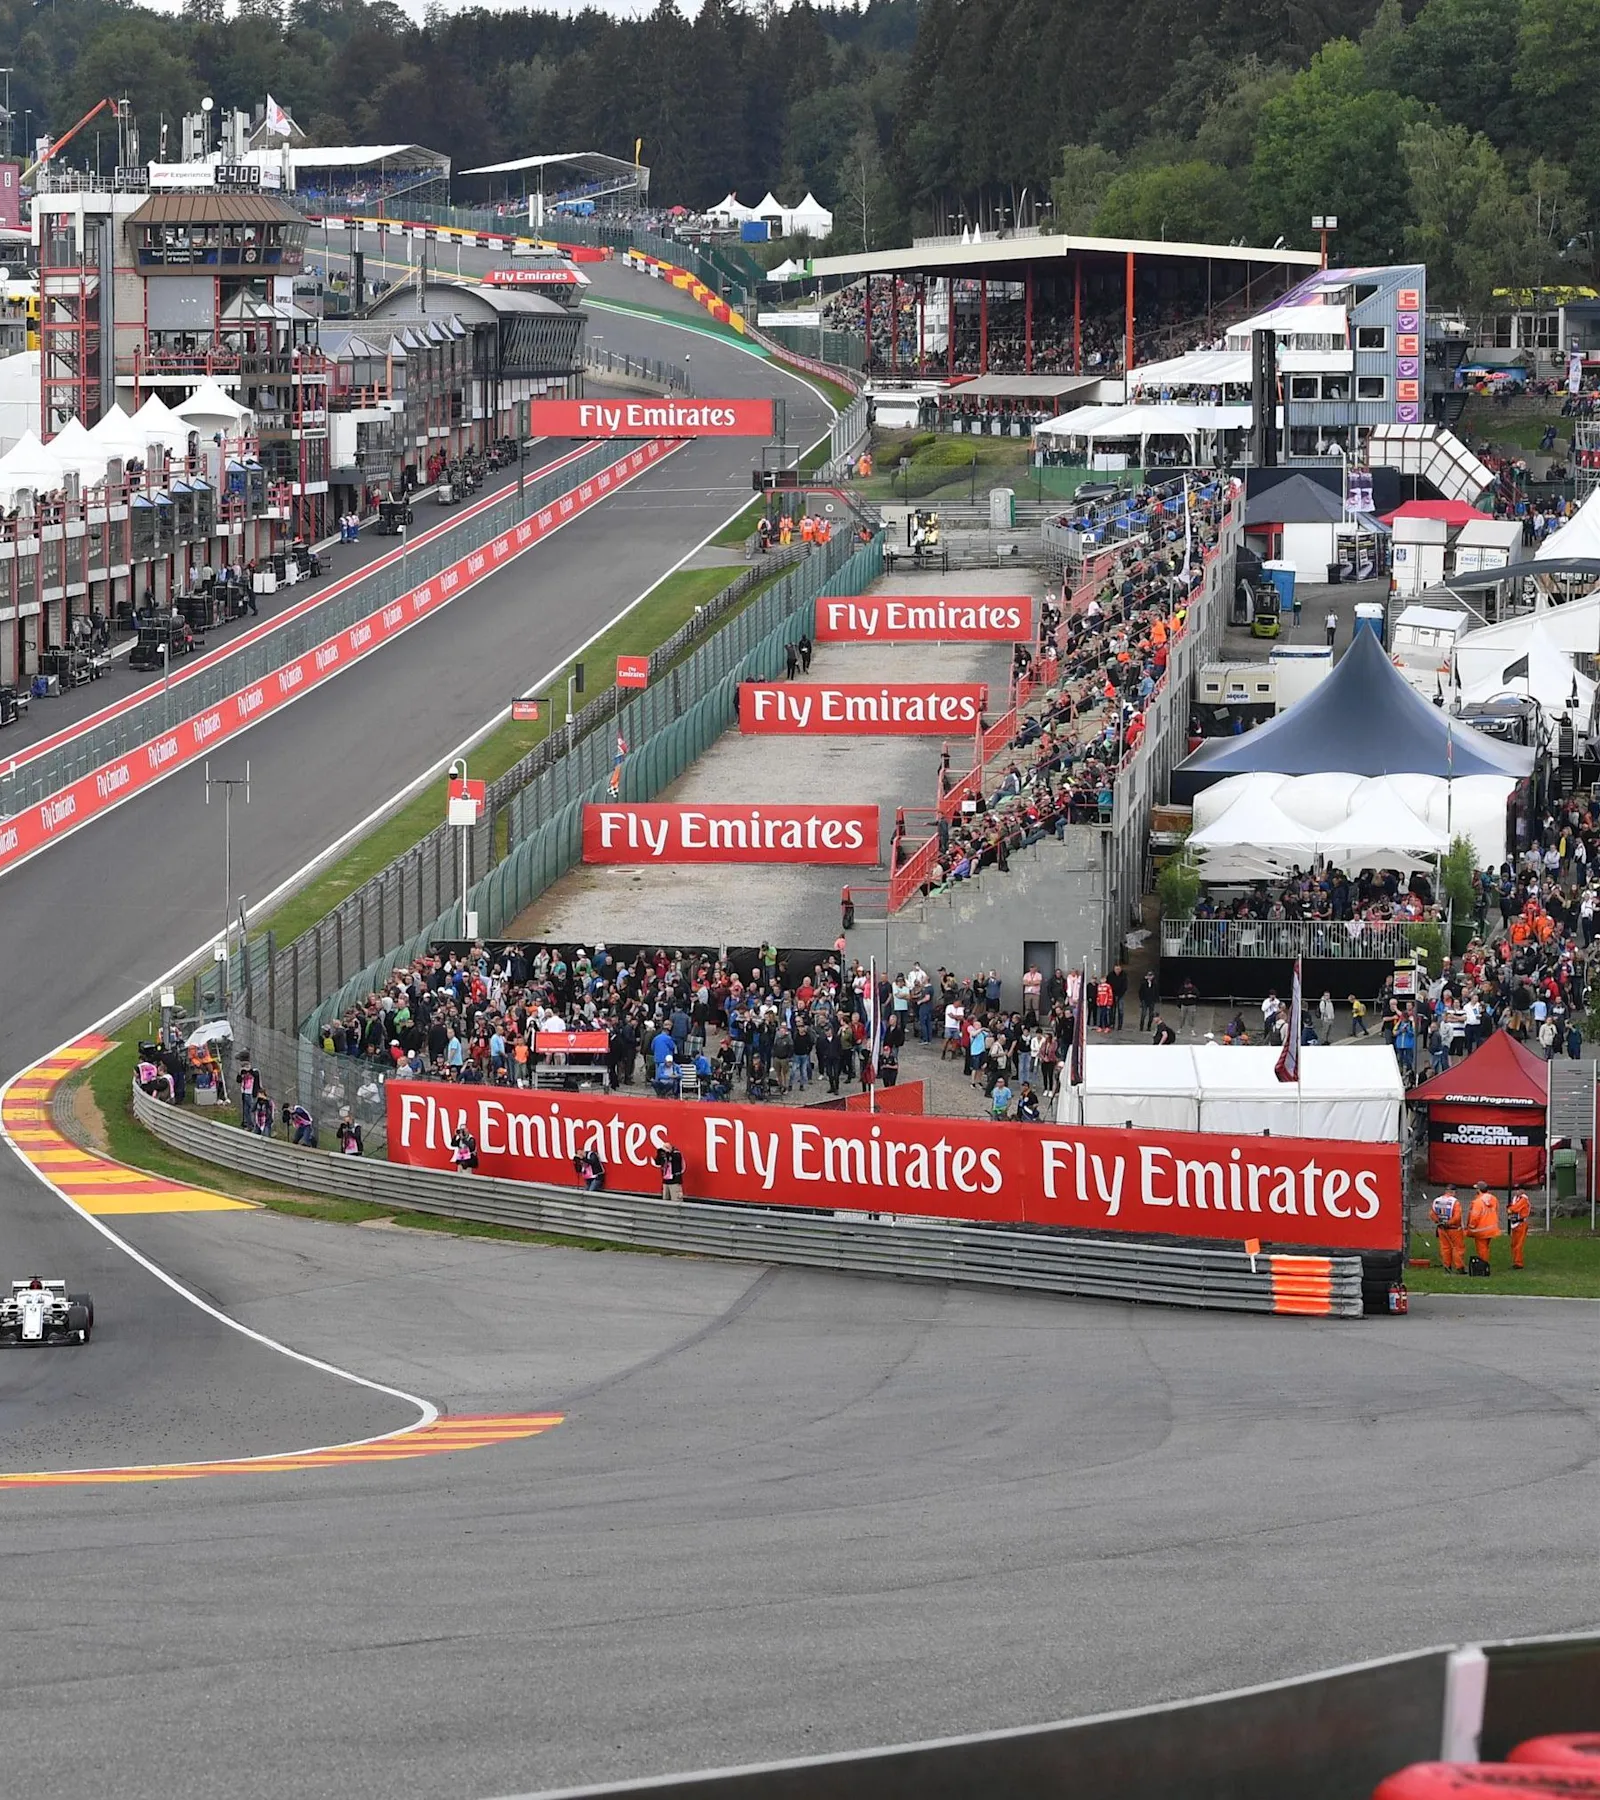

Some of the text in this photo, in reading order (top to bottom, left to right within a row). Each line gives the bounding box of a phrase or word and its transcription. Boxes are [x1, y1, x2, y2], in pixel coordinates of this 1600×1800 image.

[217, 166, 259, 183] 24.08
[494, 271, 568, 282] Fly Emirates
[580, 404, 735, 432] Fly Emirates
[1084, 534, 1092, 542] A
[828, 601, 1020, 635] Fly Emirates
[618, 670, 646, 678] Emirates
[246, 688, 263, 712] Emirates
[754, 690, 976, 727] Fly Emirates
[202, 712, 221, 738] Emirates
[148, 737, 178, 770] Fly Emirates
[97, 764, 129, 799] Fly Emirates
[41, 794, 76, 831] Fly Emirates
[600, 811, 863, 854] Fly Emirates
[1445, 1094, 1534, 1105] Official Programme
[400, 1094, 668, 1168] Fly Emirates
[1442, 1133, 1529, 1146] PROGRAMME
[1457, 1124, 1513, 1136] OFFICIAL
[705, 1116, 1003, 1194] Fly Emirates
[1041, 1140, 1380, 1219] Fly Emirates
